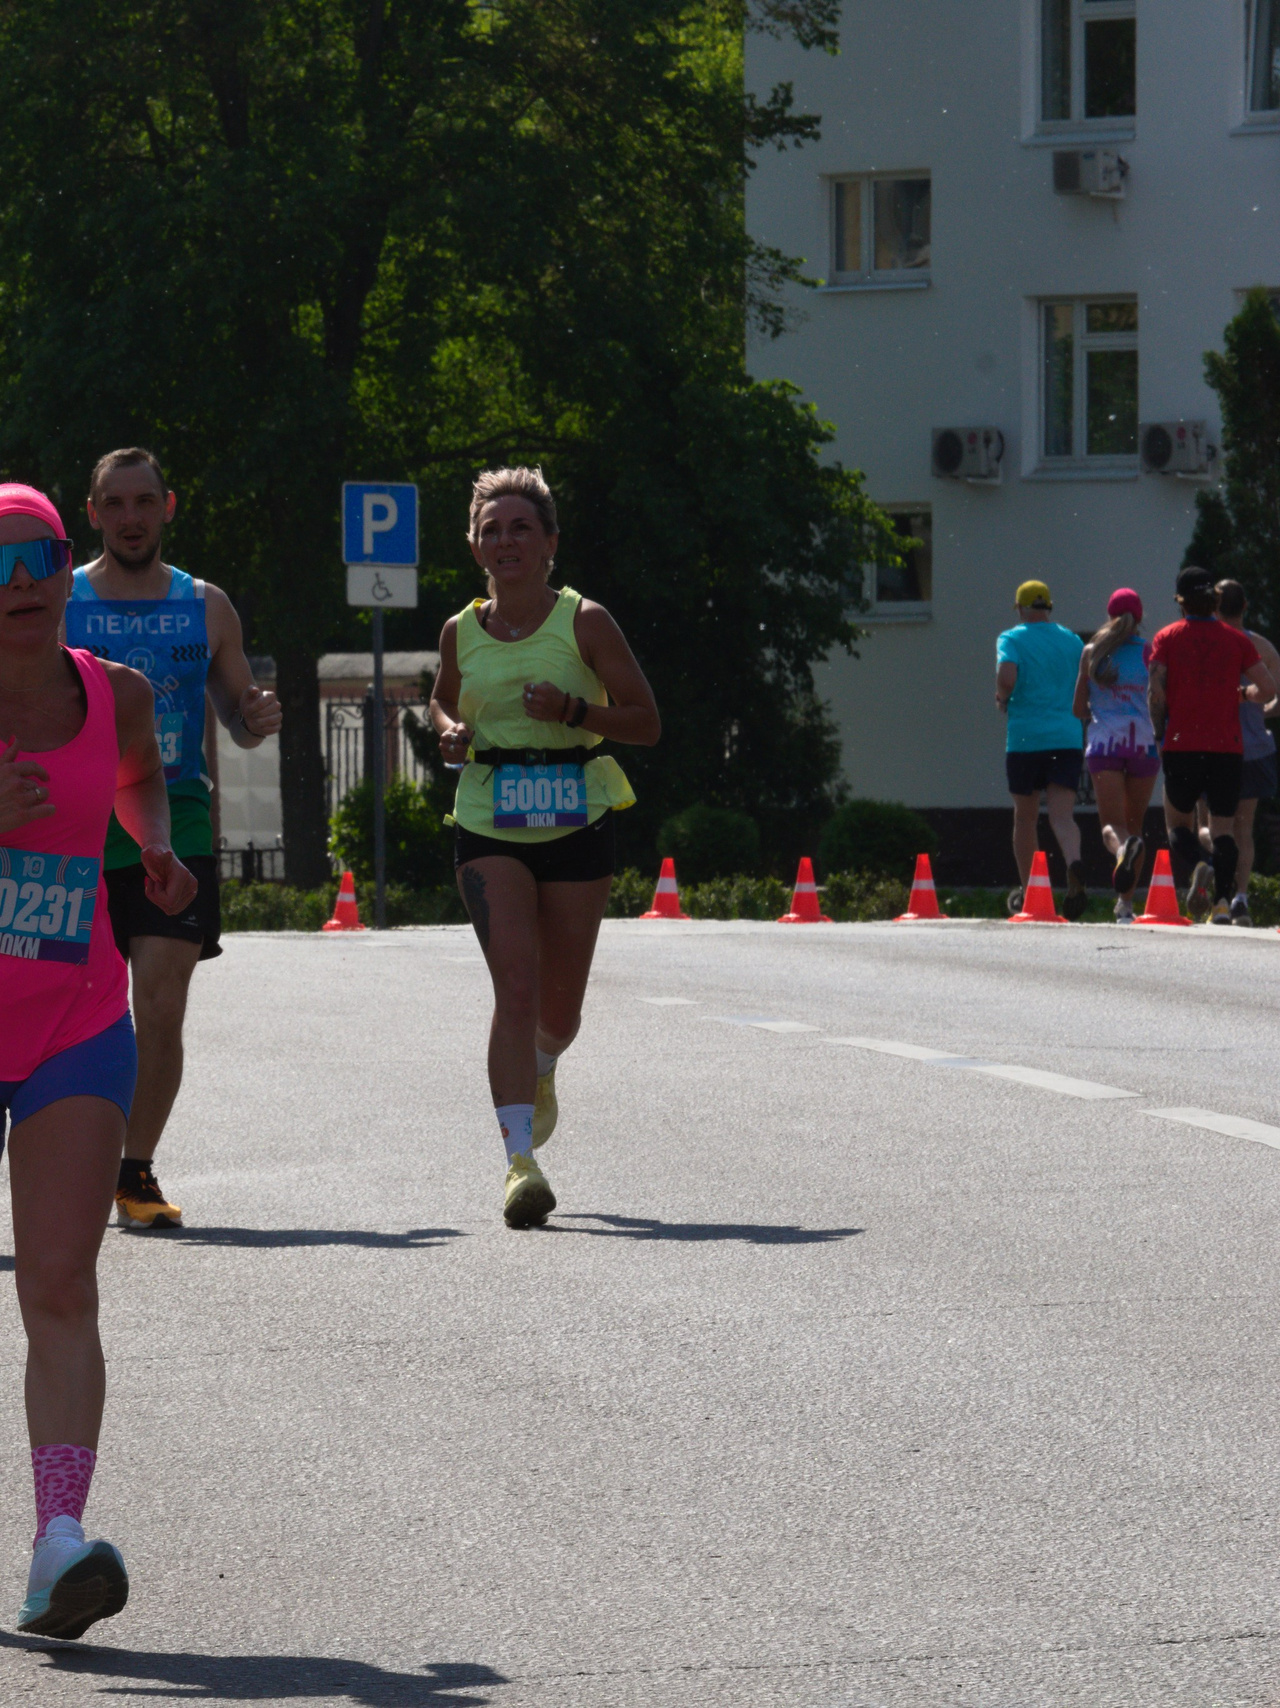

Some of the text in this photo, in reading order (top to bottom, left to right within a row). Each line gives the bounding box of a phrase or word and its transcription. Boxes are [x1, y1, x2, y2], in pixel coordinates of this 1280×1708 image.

[363, 493, 398, 555] P
[86, 611, 190, 635] ПЕЙСЕР
[501, 778, 578, 812] 50013
[525, 813, 556, 828] 10KM
